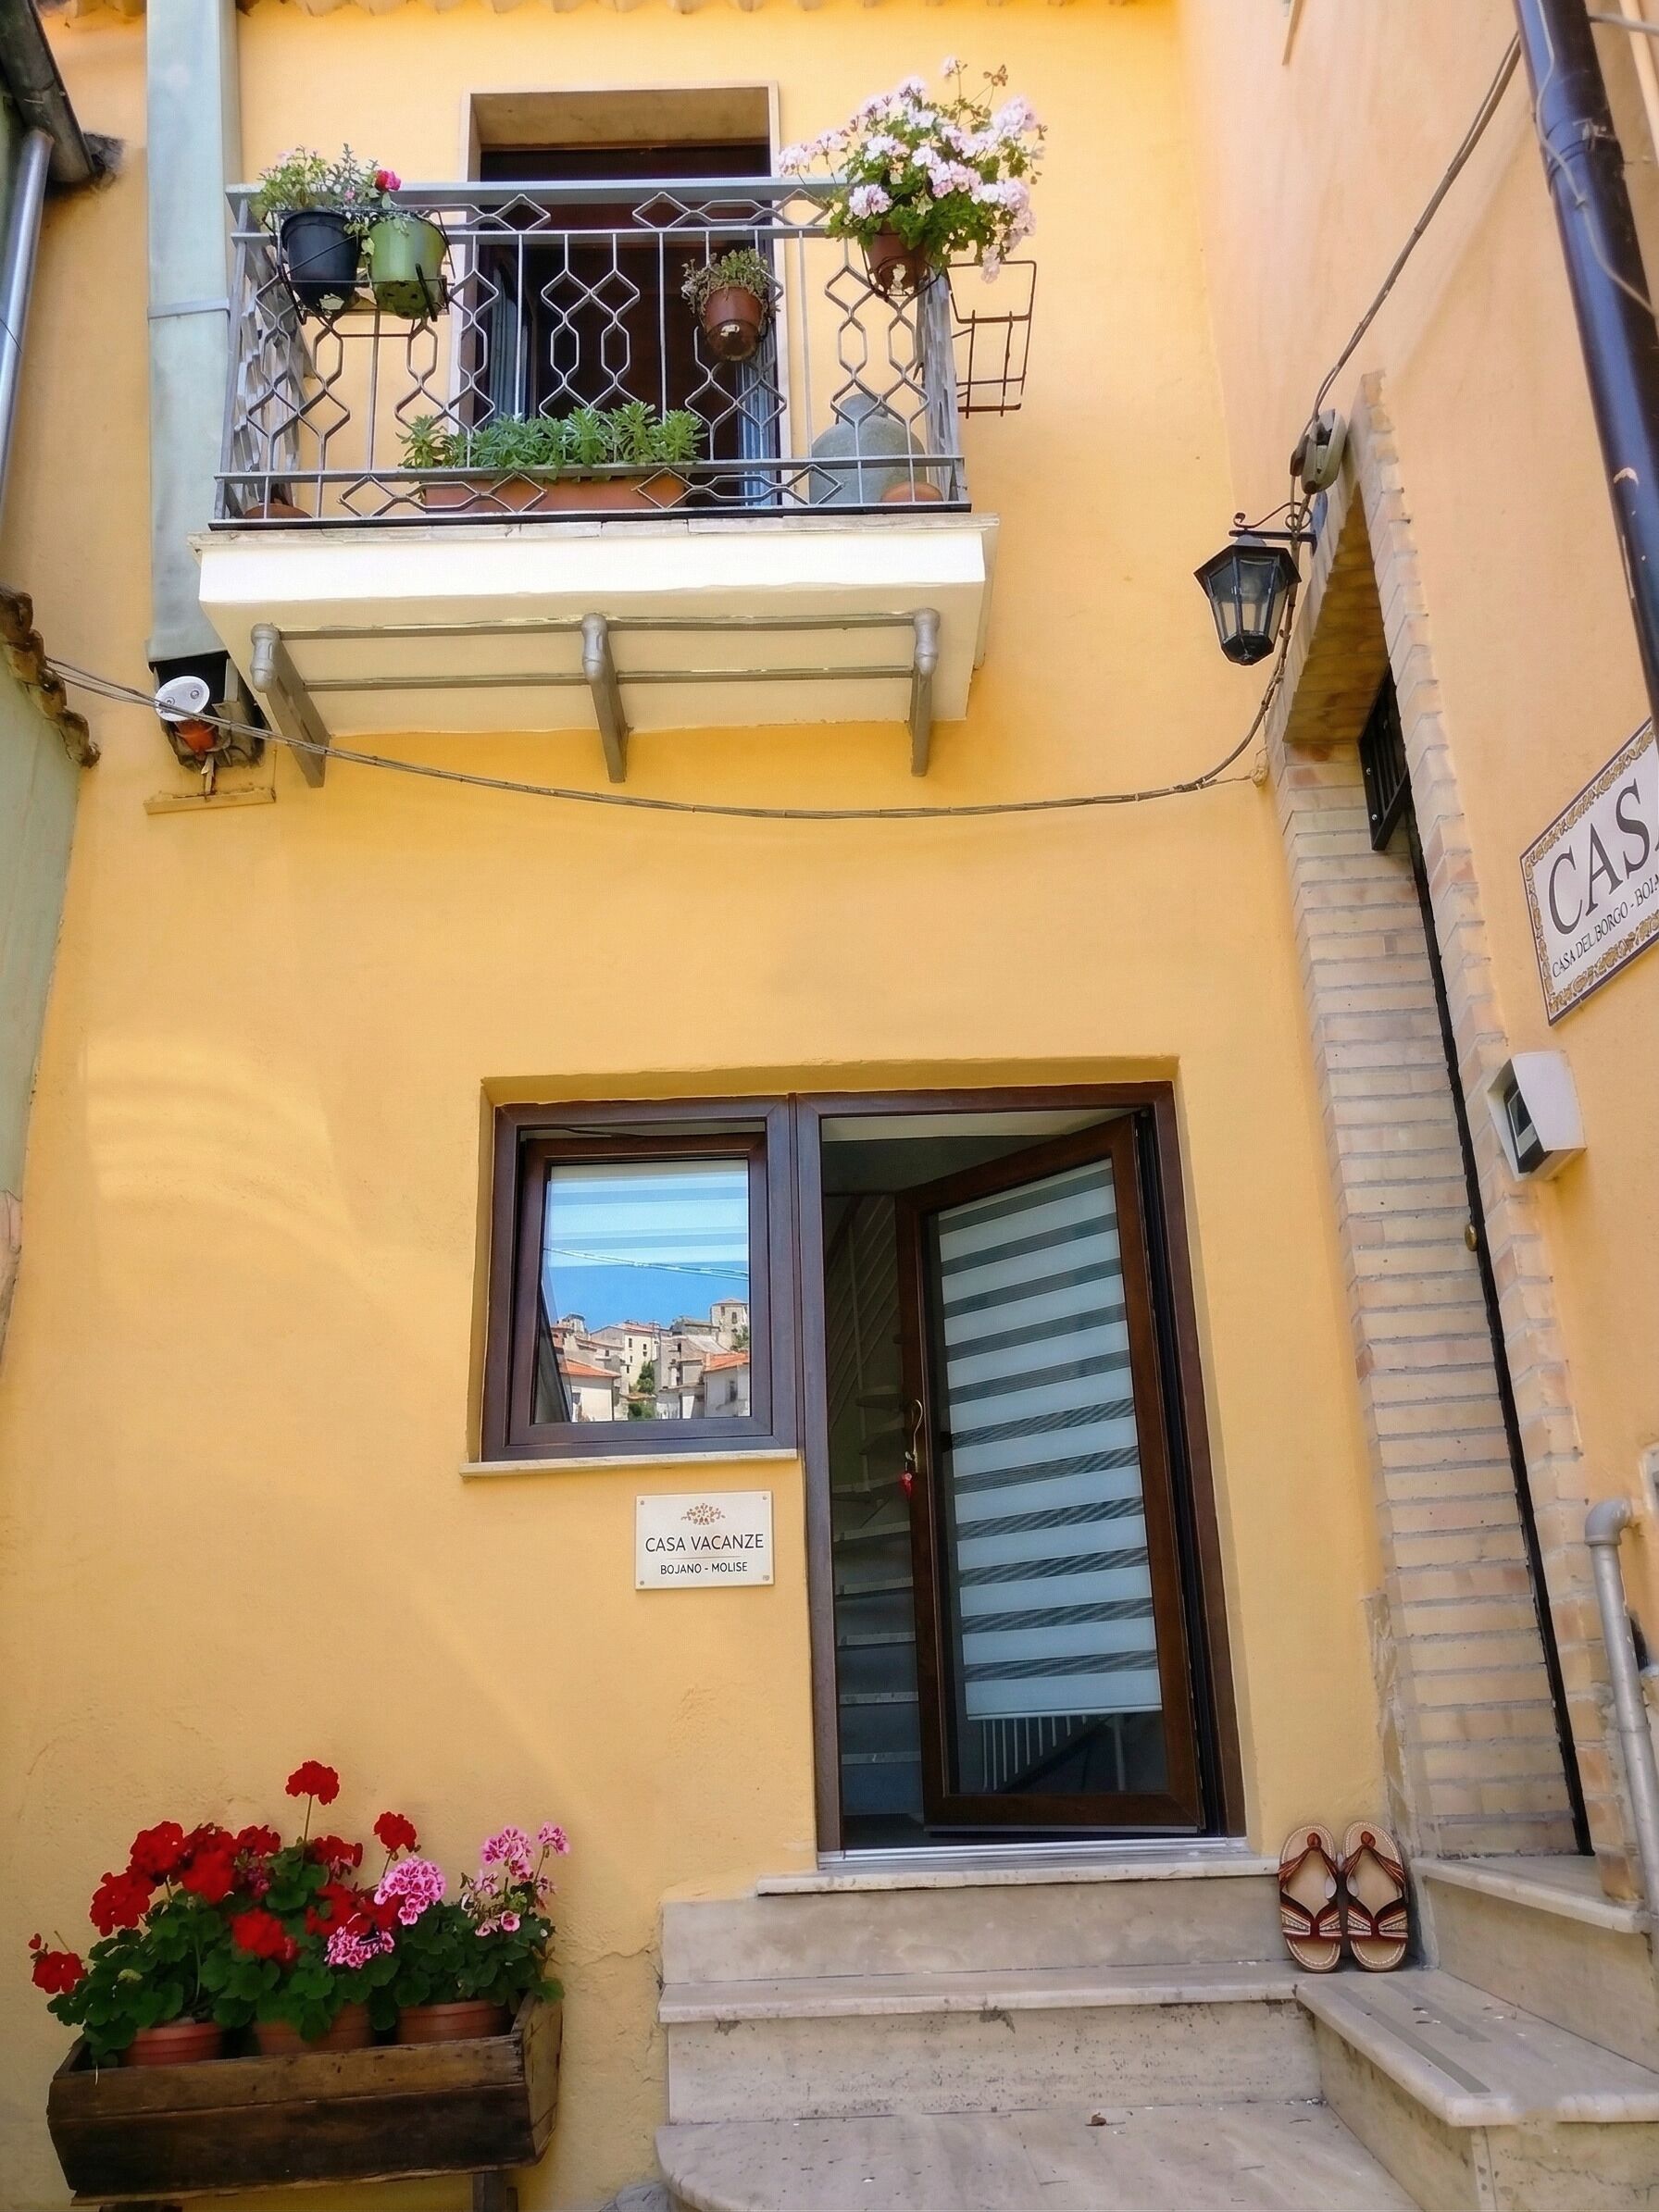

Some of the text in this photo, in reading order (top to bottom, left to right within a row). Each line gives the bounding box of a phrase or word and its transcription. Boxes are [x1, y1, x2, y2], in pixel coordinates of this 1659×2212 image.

[1549, 777, 1659, 935] CAS
[1552, 949, 1576, 977] CASA
[1576, 932, 1595, 959] DEL
[1594, 901, 1628, 942] BORGO
[645, 1534, 764, 1552] CASA VACANZE
[660, 1563, 702, 1575] BOJANO
[711, 1561, 748, 1572] MOLISE
